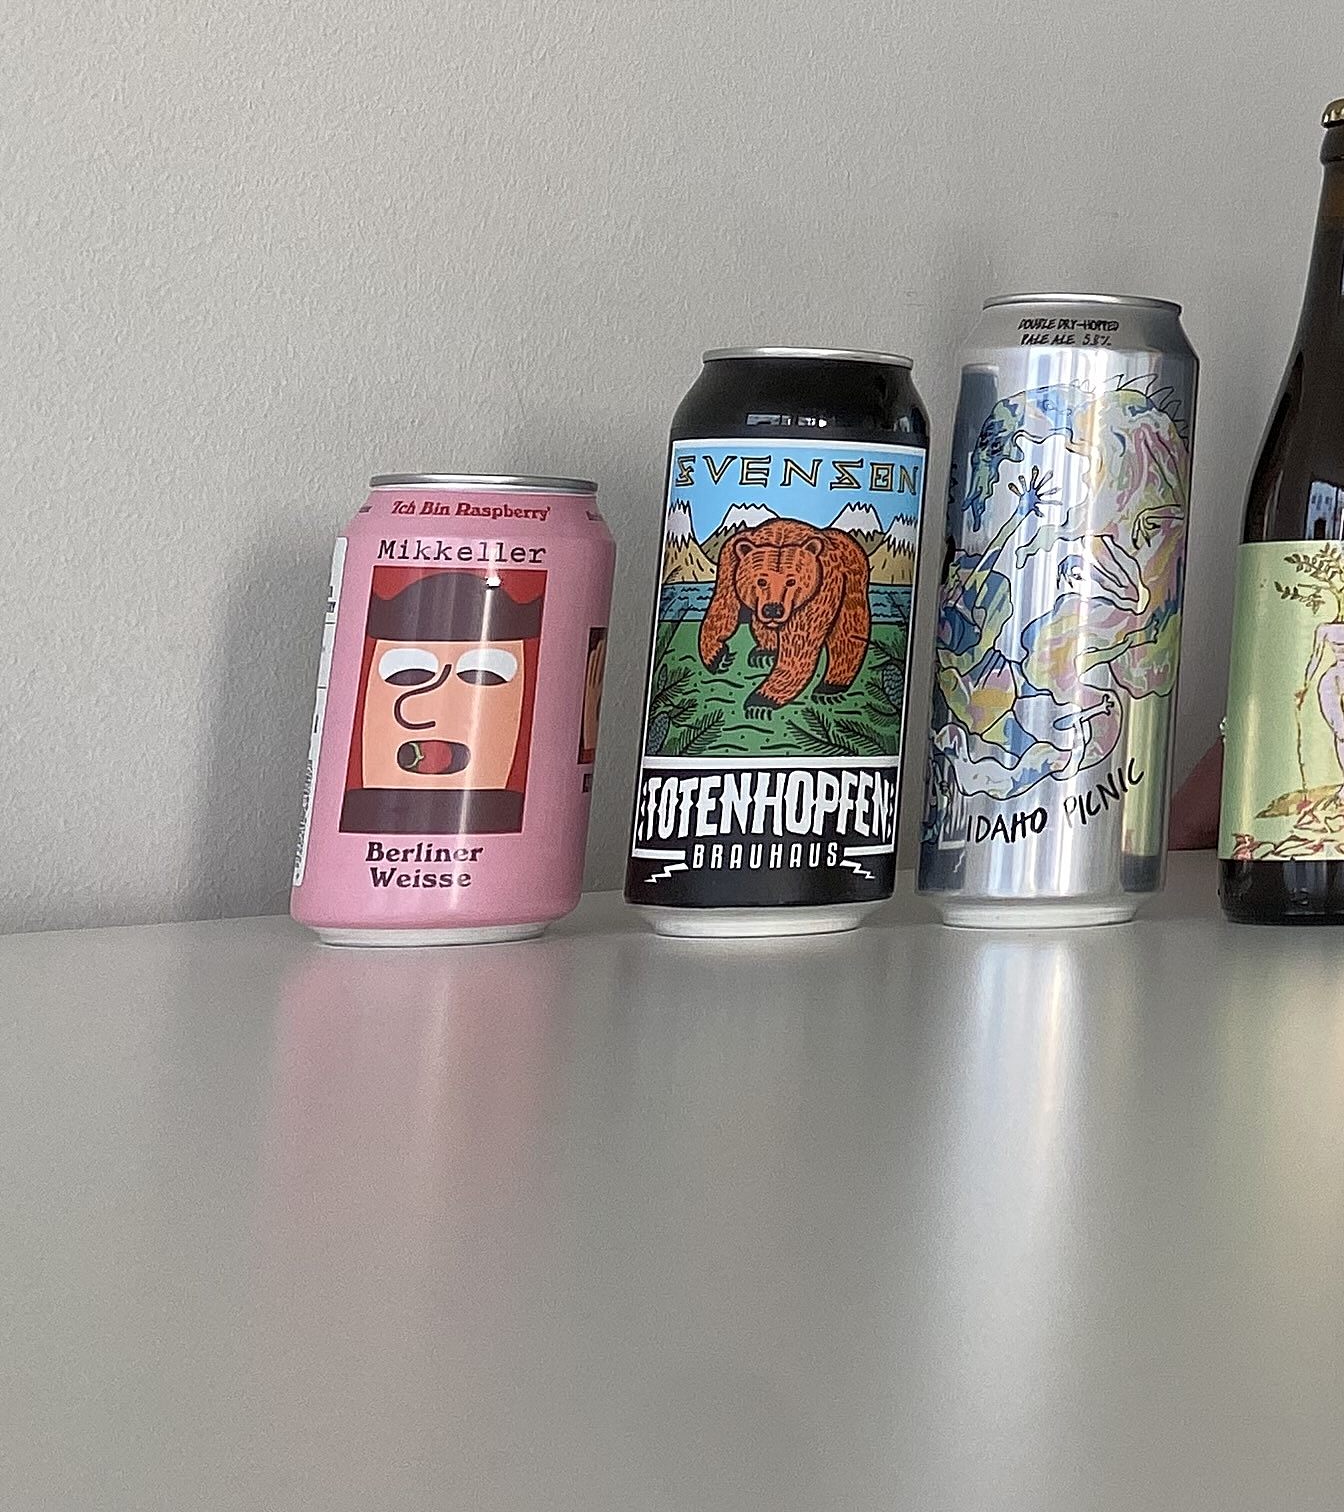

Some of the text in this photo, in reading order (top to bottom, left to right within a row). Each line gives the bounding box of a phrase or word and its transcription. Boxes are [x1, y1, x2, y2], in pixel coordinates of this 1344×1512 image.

[1017, 319, 1057, 330] DOUBLE
[1021, 334, 1049, 346] PALE
[1051, 334, 1075, 345] ALE
[675, 455, 919, 496] SVENSON
[419, 501, 450, 516] Bin
[377, 539, 547, 563] Mikkeller
[646, 770, 890, 843] TOTENHOPFEN
[966, 757, 1145, 844] IDAHO PICNIC
[365, 842, 484, 863] Berliner
[692, 842, 838, 869] BRAUHAUS
[369, 867, 472, 889] Weisse
